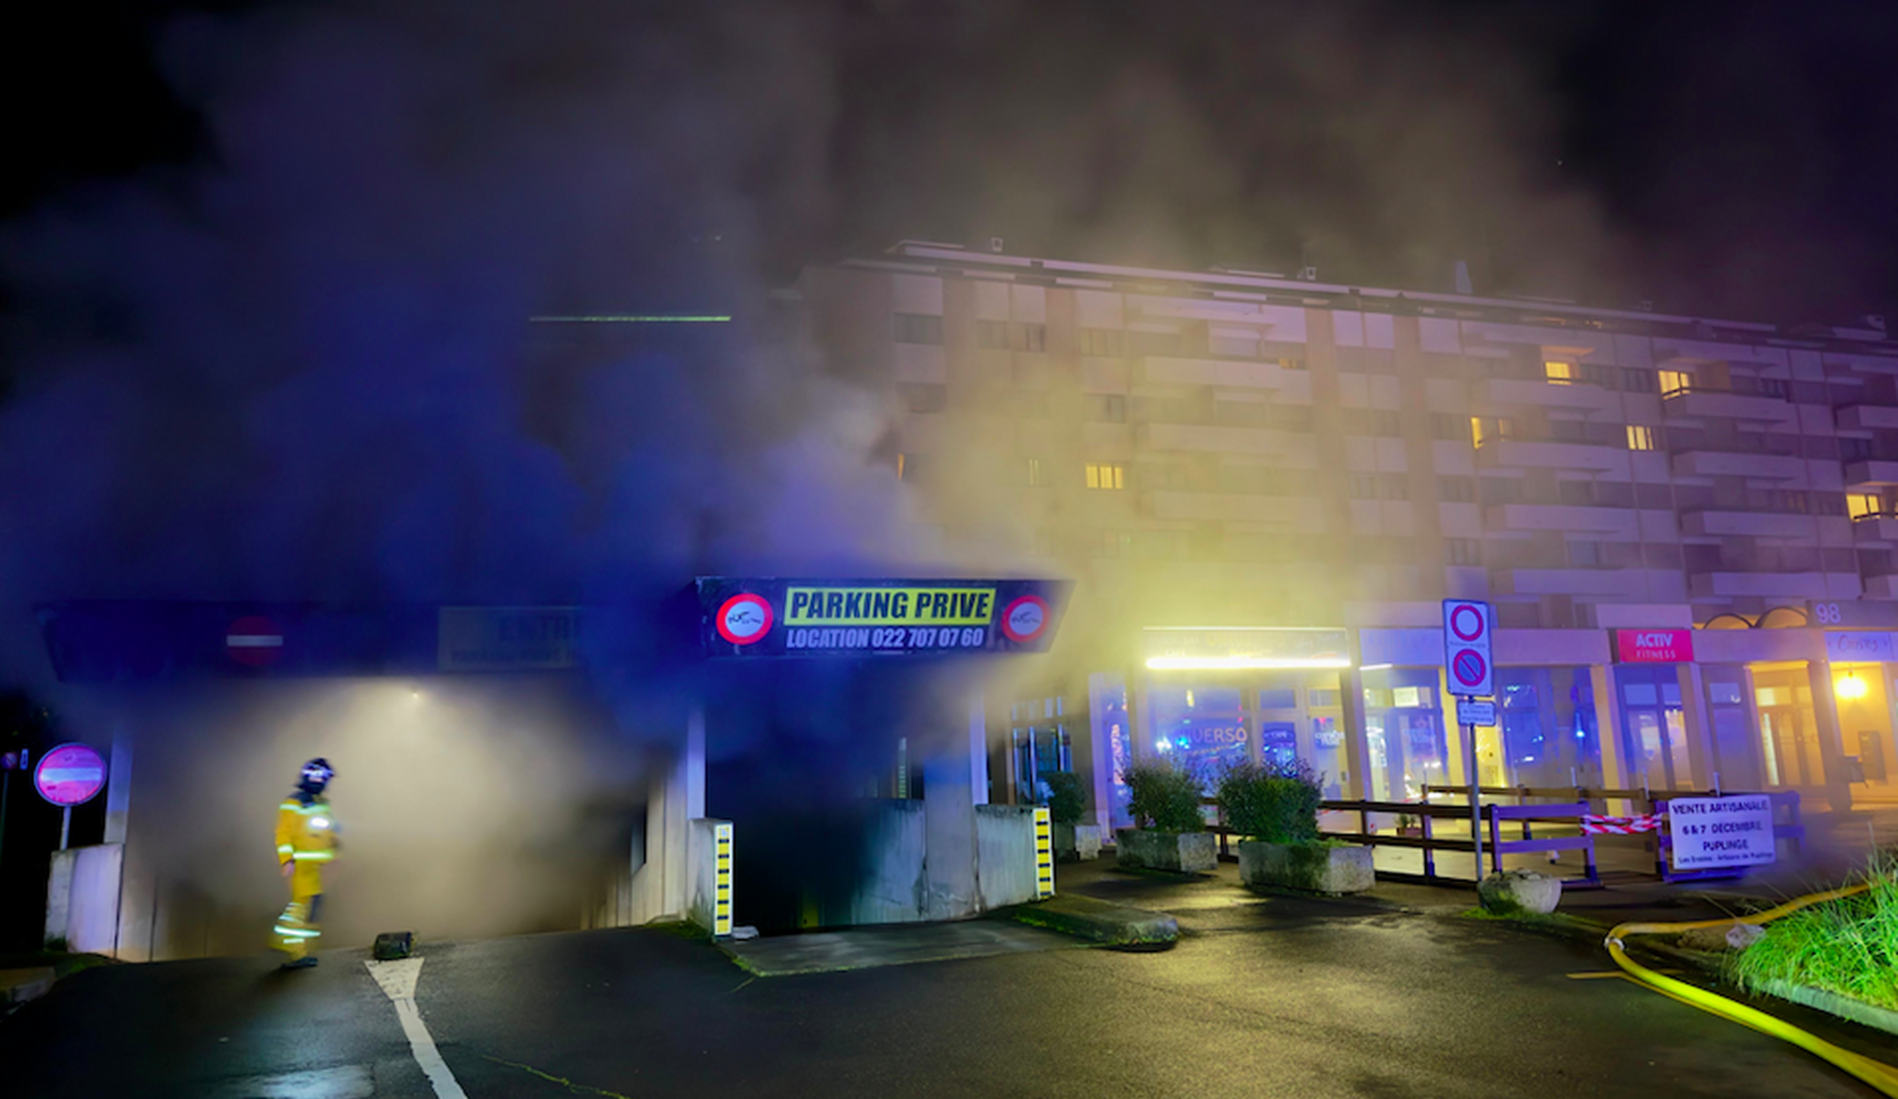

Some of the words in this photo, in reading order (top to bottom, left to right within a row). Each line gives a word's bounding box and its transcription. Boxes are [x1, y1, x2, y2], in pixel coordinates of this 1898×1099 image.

[790, 591, 909, 619] PARKING
[914, 592, 990, 619] PRIVE
[1815, 602, 1842, 625] 98
[786, 628, 870, 649] LOCATION
[871, 627, 906, 649] 022
[908, 627, 938, 648] 707
[938, 627, 960, 648] 07
[960, 627, 984, 647] 60
[1635, 632, 1674, 648] ACTIV
[1636, 649, 1677, 660] FITNESS
[1672, 803, 1707, 815] VENTE
[1709, 799, 1770, 814] ARTISANALE
[1703, 838, 1750, 852] PUPLINGE
